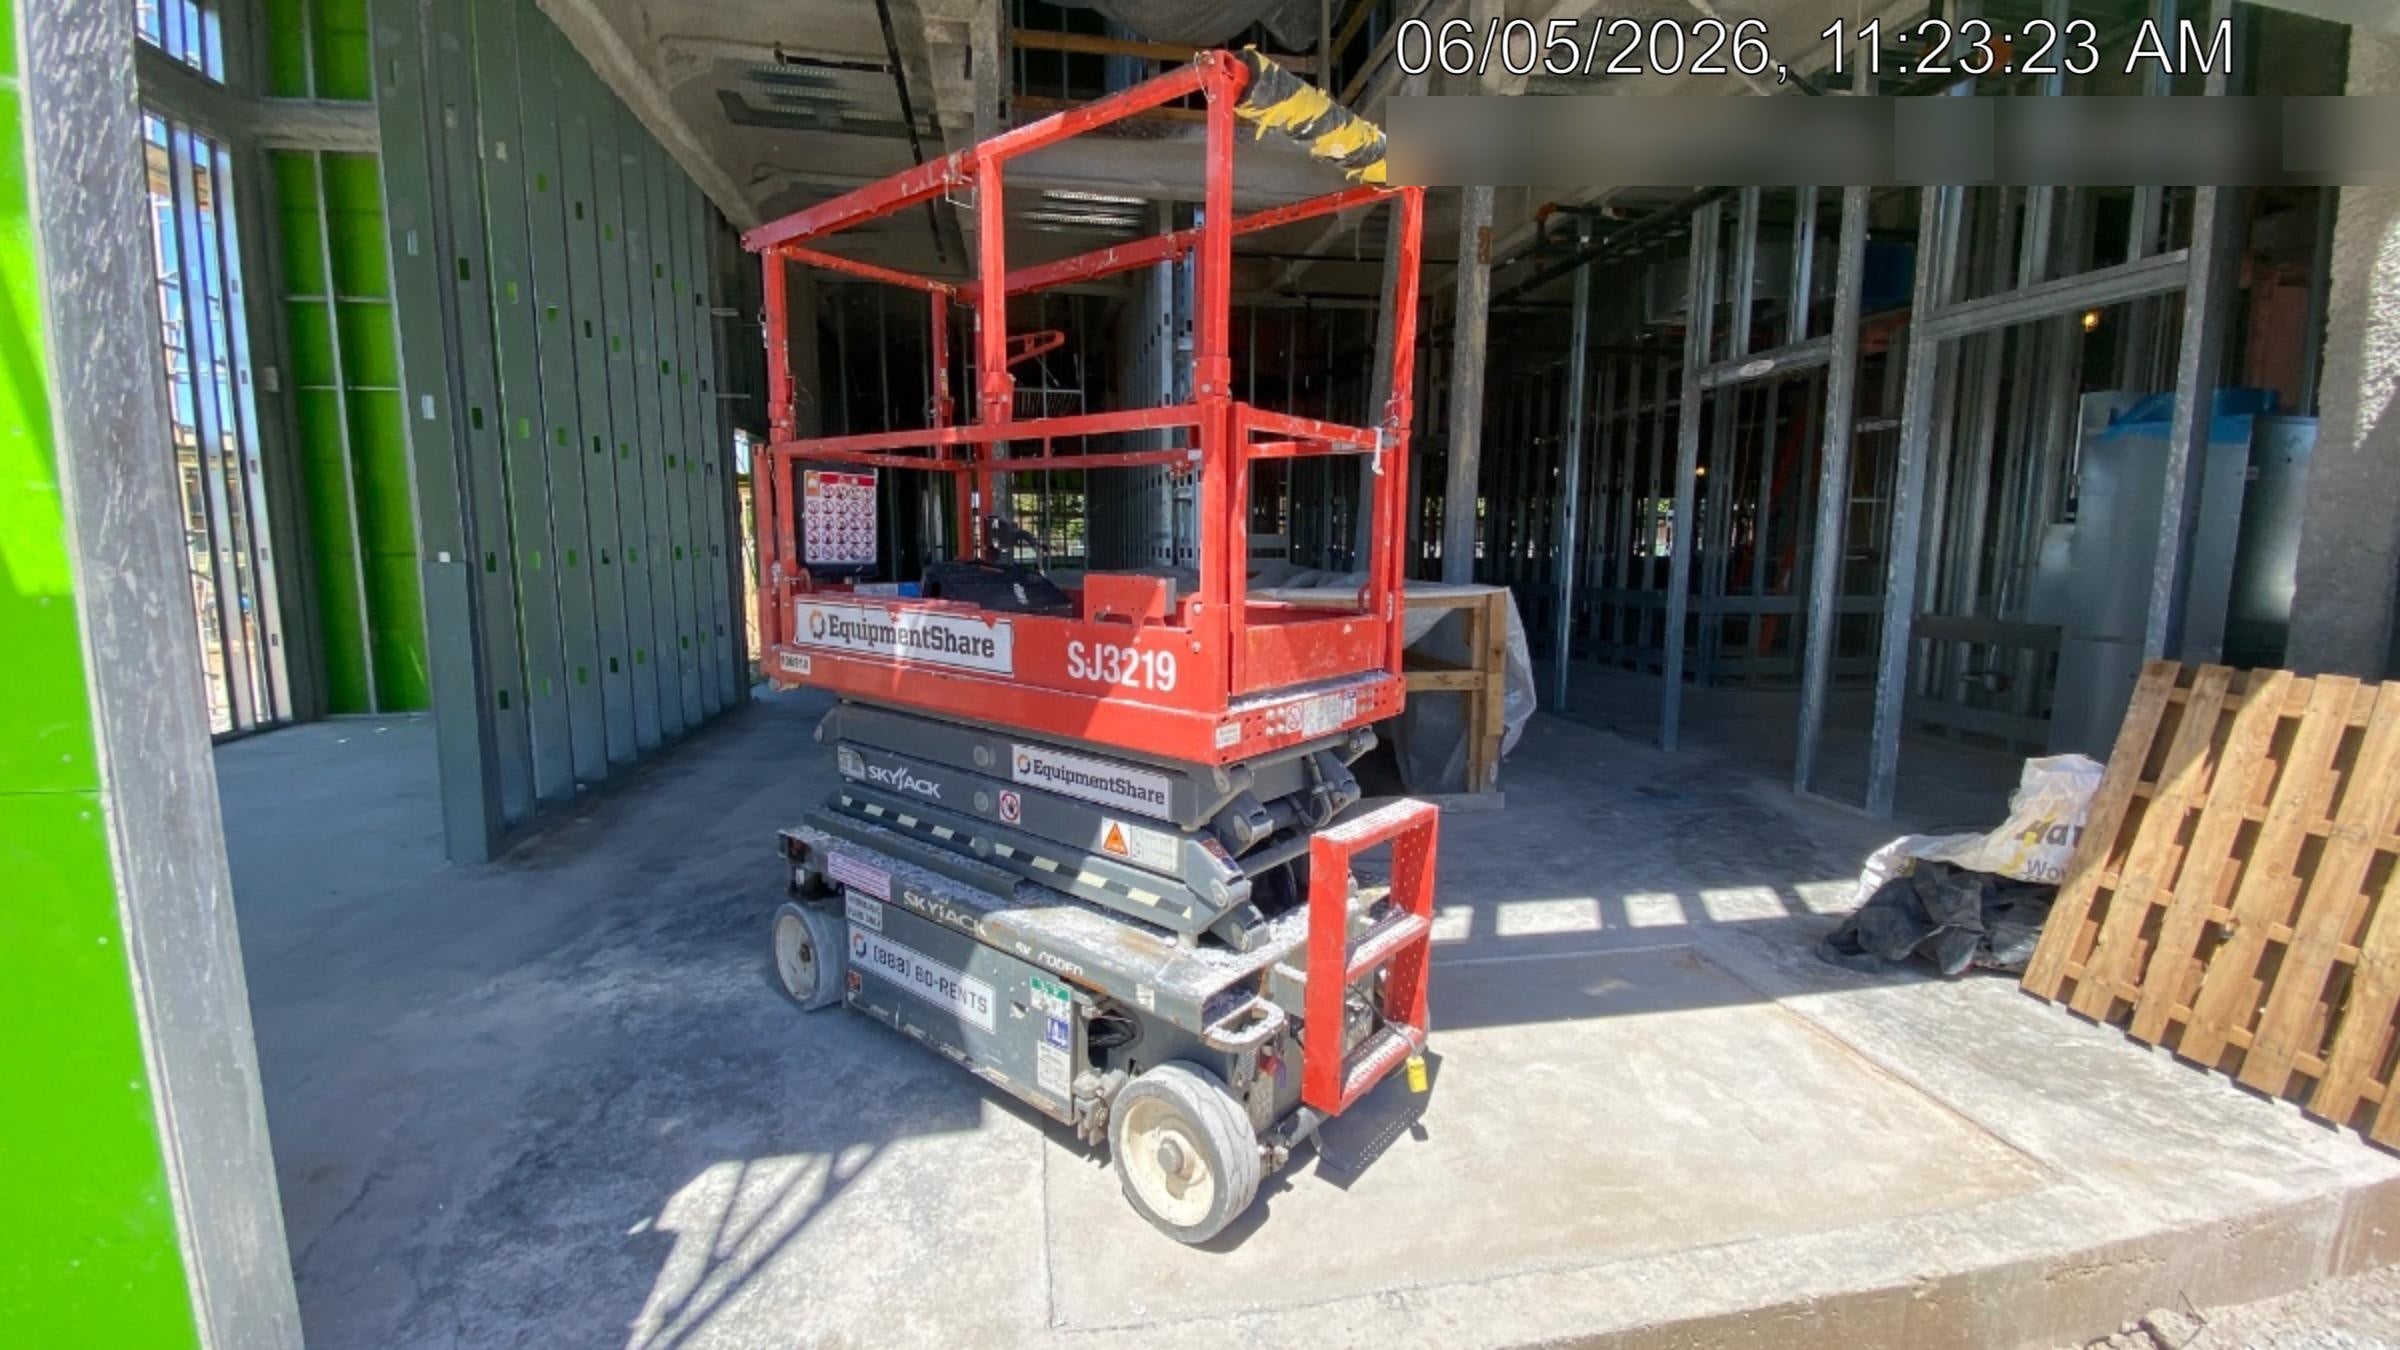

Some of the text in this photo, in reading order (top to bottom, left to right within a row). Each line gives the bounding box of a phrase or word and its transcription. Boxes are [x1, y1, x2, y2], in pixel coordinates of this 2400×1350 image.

[828, 614, 995, 658] EquipmentShare
[1067, 640, 1177, 692] SJ3219
[867, 765, 941, 799] SKYJACK
[1033, 759, 1165, 805] EquipmentShare
[873, 944, 911, 977] (888)
